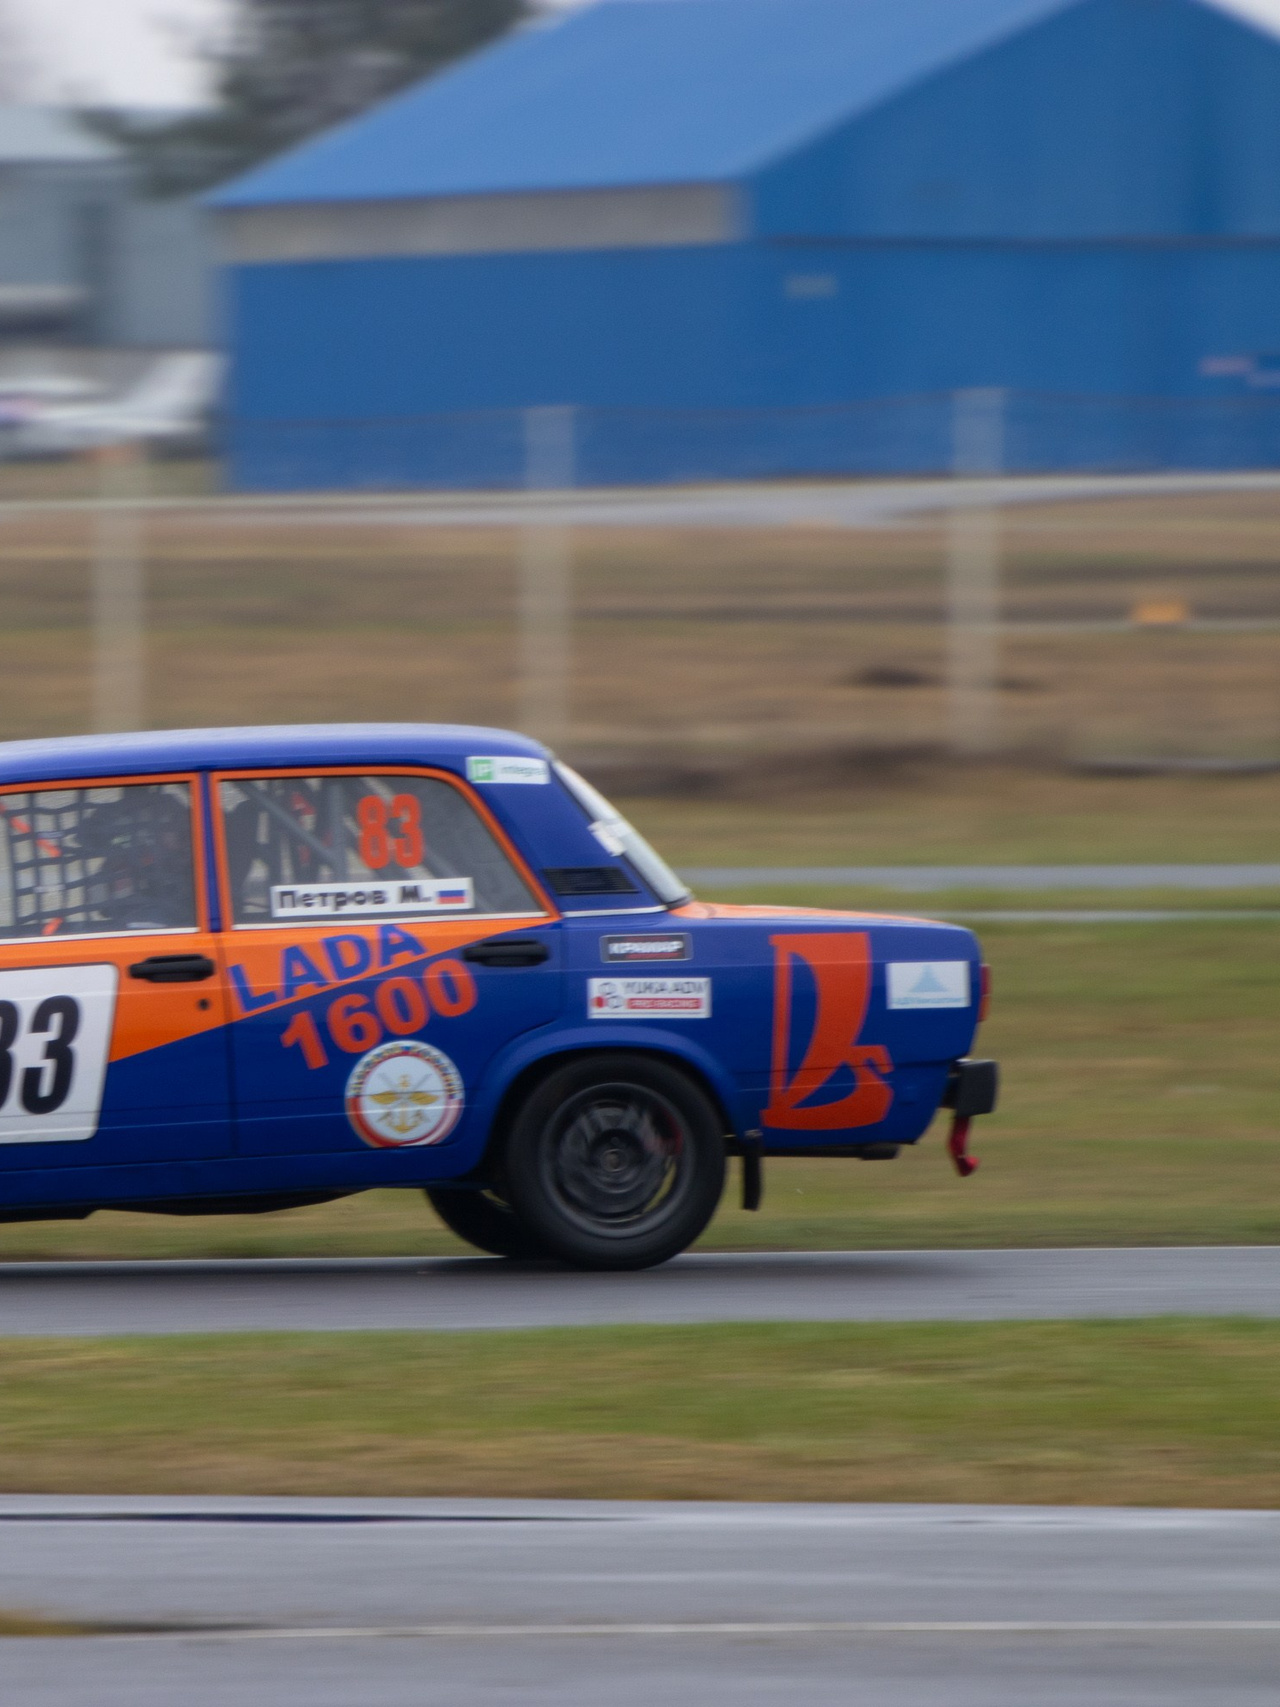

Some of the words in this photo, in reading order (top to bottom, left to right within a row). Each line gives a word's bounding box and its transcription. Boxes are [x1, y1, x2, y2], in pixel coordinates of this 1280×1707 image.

[357, 793, 424, 870] 83
[278, 889, 388, 912] Петров
[227, 923, 428, 1013] LADA
[280, 958, 478, 1071] 1600
